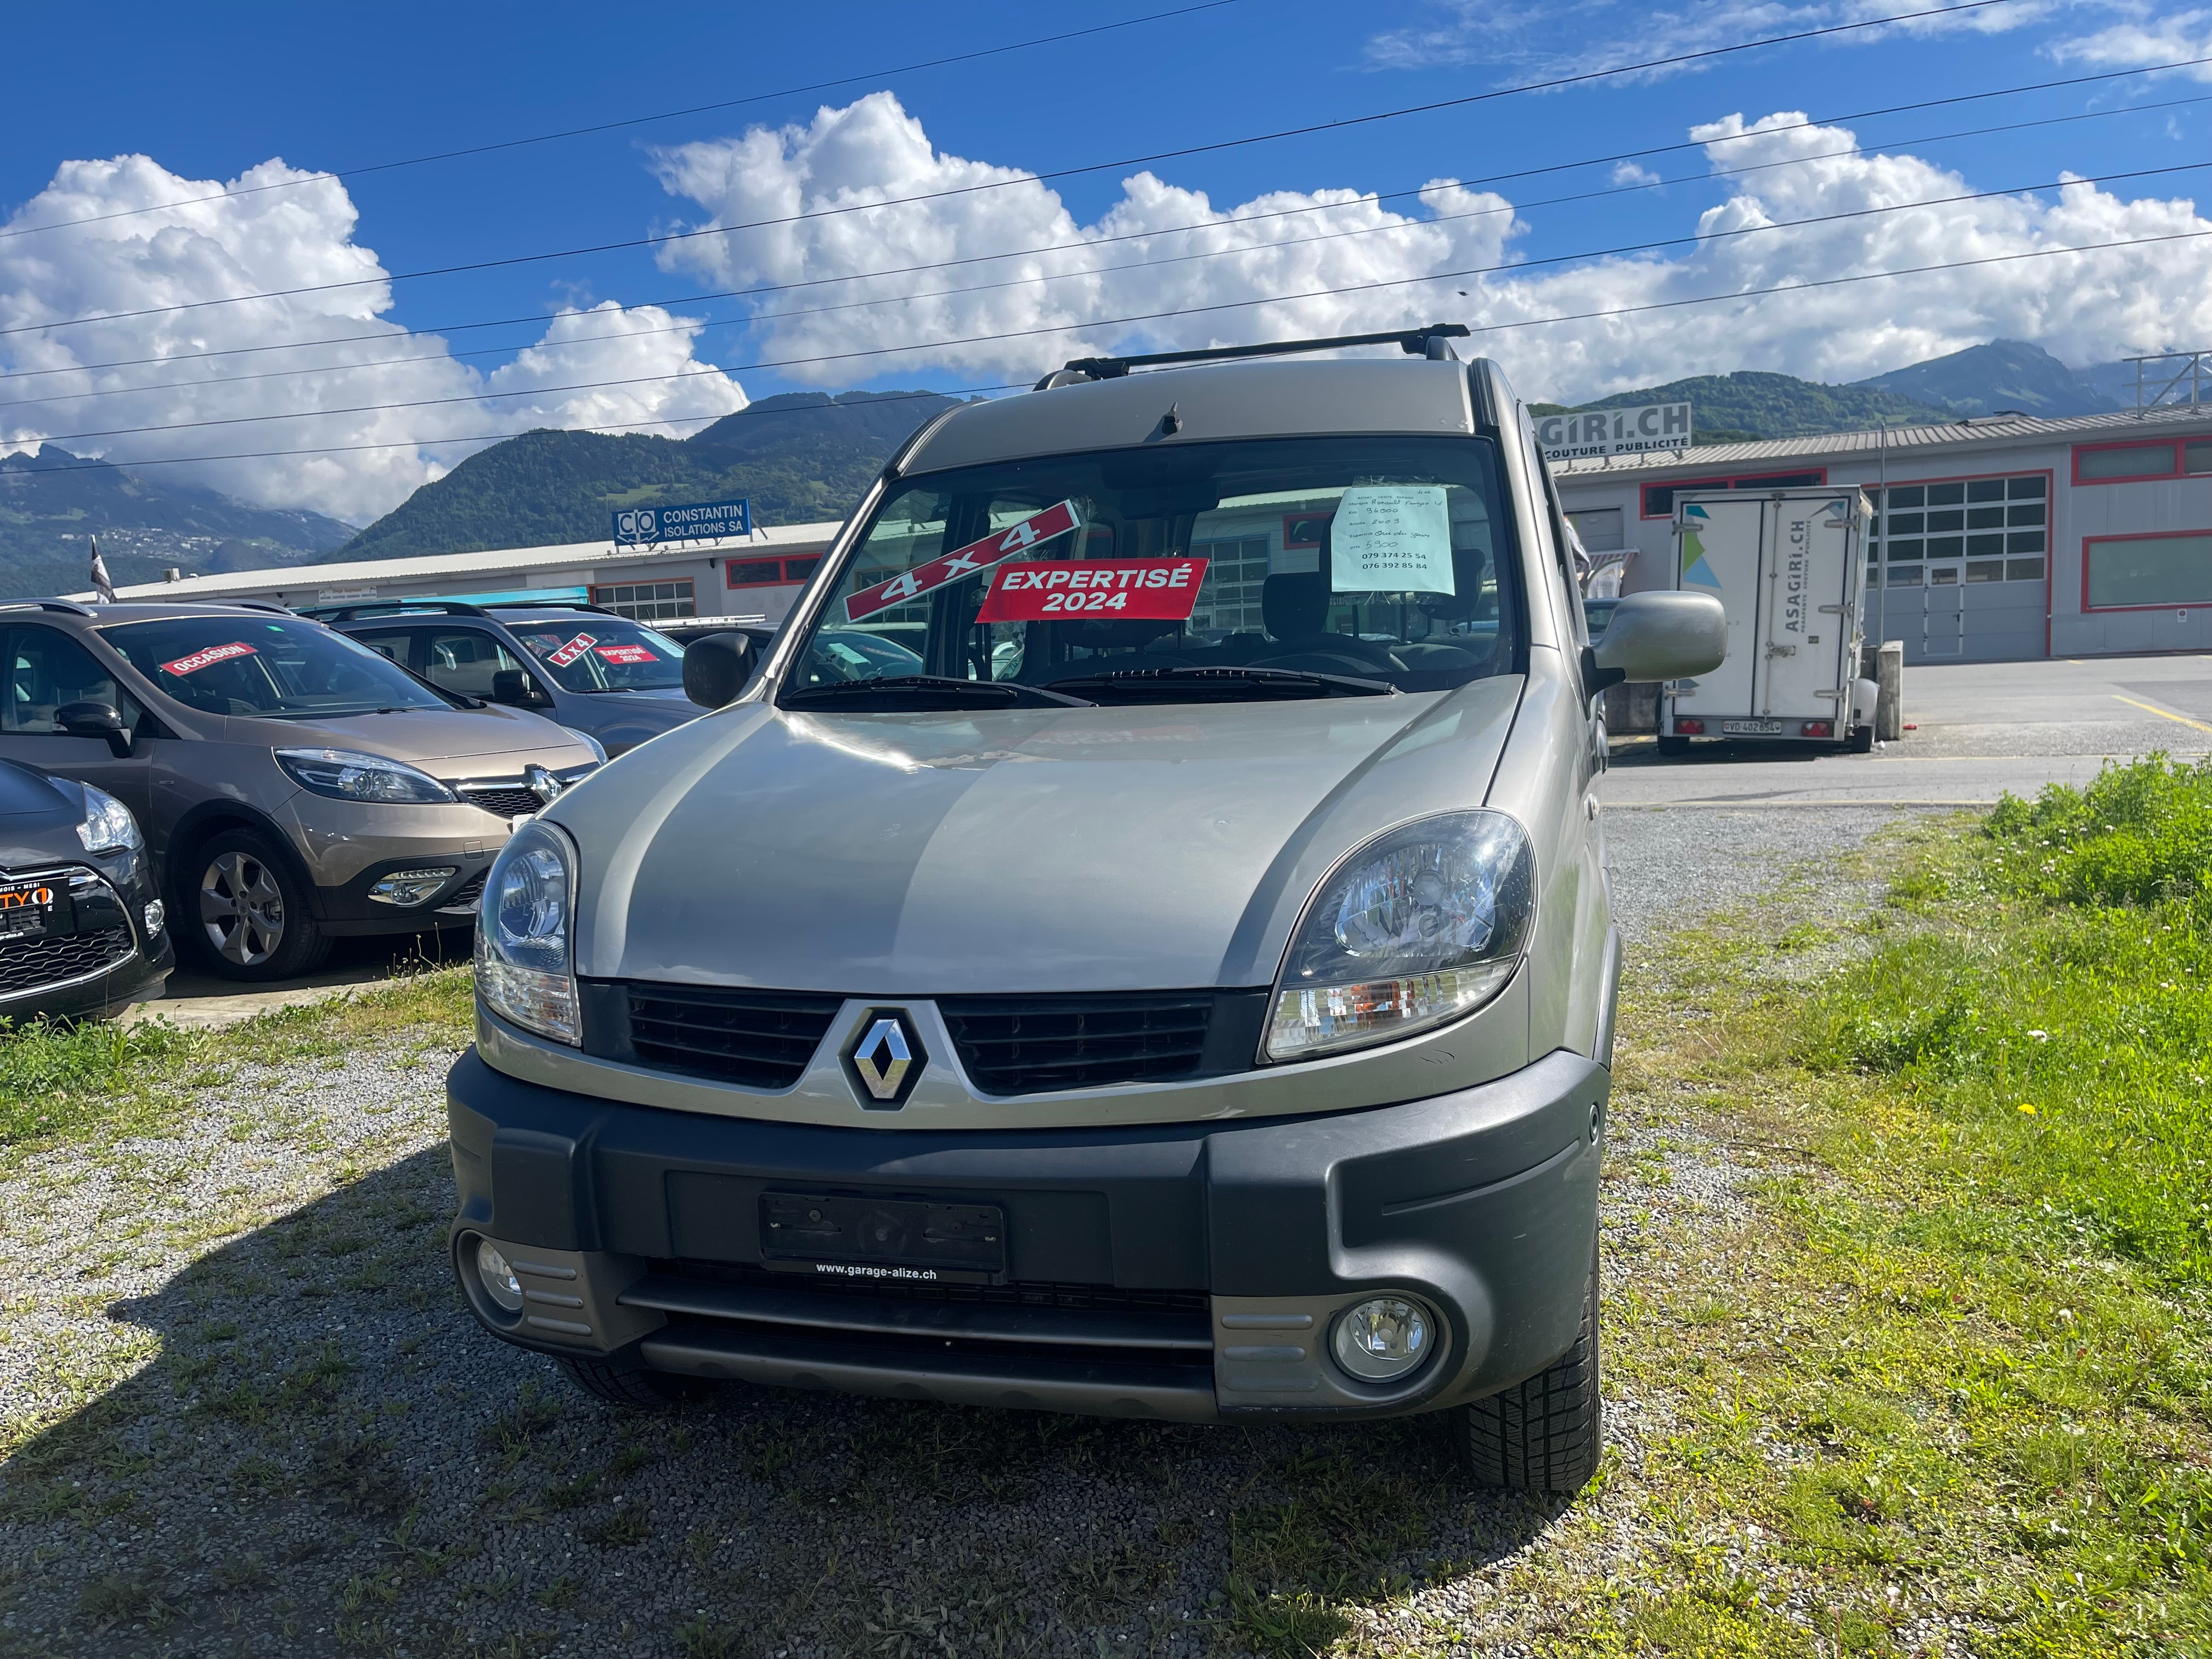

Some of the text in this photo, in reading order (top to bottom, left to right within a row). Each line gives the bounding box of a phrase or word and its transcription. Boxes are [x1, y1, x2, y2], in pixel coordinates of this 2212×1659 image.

[1616, 436, 1688, 452] PUBLICITÉ
[663, 505, 742, 523] CONSTANTIN
[664, 521, 743, 537] ISOLATIONS SA
[1364, 540, 1398, 549] 5900
[1001, 563, 1193, 590] EXPERTISÉ
[1042, 592, 1126, 611] 2024
[173, 645, 247, 671] OCCASION
[599, 646, 646, 656] EXPERTISÉ
[1730, 723, 1740, 731] VD
[816, 1263, 937, 1279] www.garage-alize.ch
